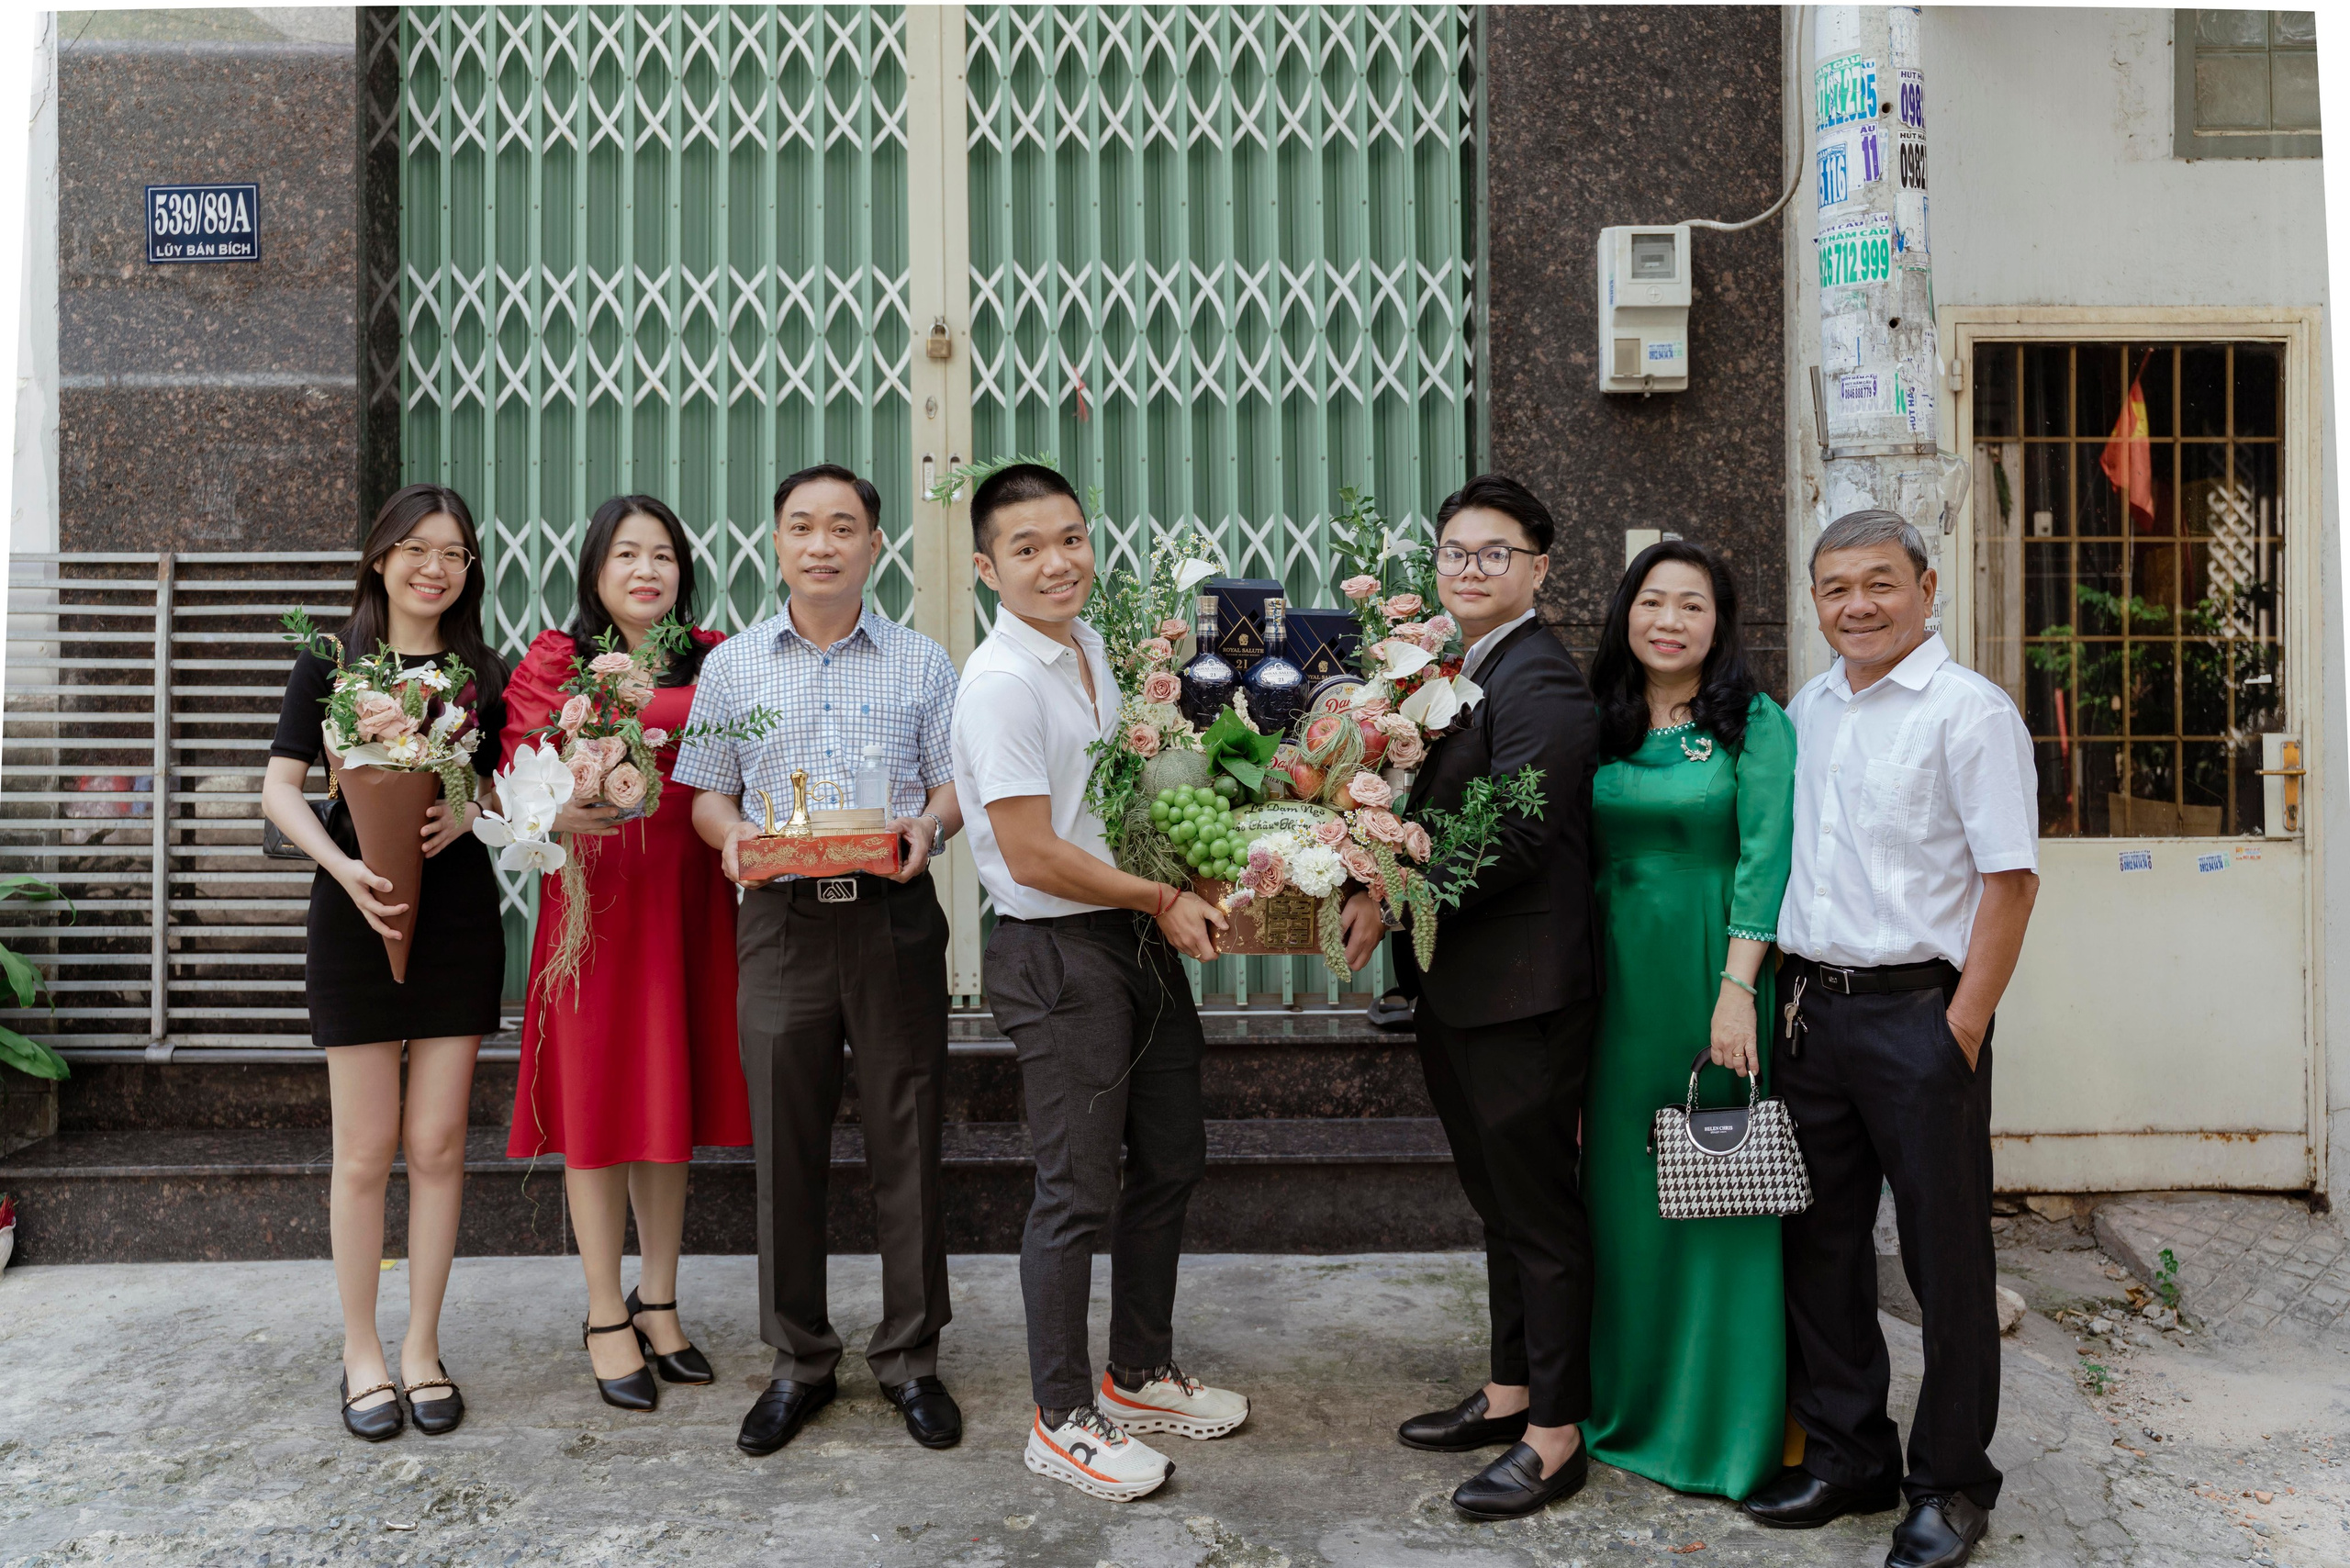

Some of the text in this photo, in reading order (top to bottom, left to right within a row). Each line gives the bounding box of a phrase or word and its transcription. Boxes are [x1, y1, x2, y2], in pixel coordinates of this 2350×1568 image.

[155, 192, 251, 235] 539/89A
[157, 241, 251, 257] LŨY BÁN BÍCH
[1236, 659, 1248, 669] 21
